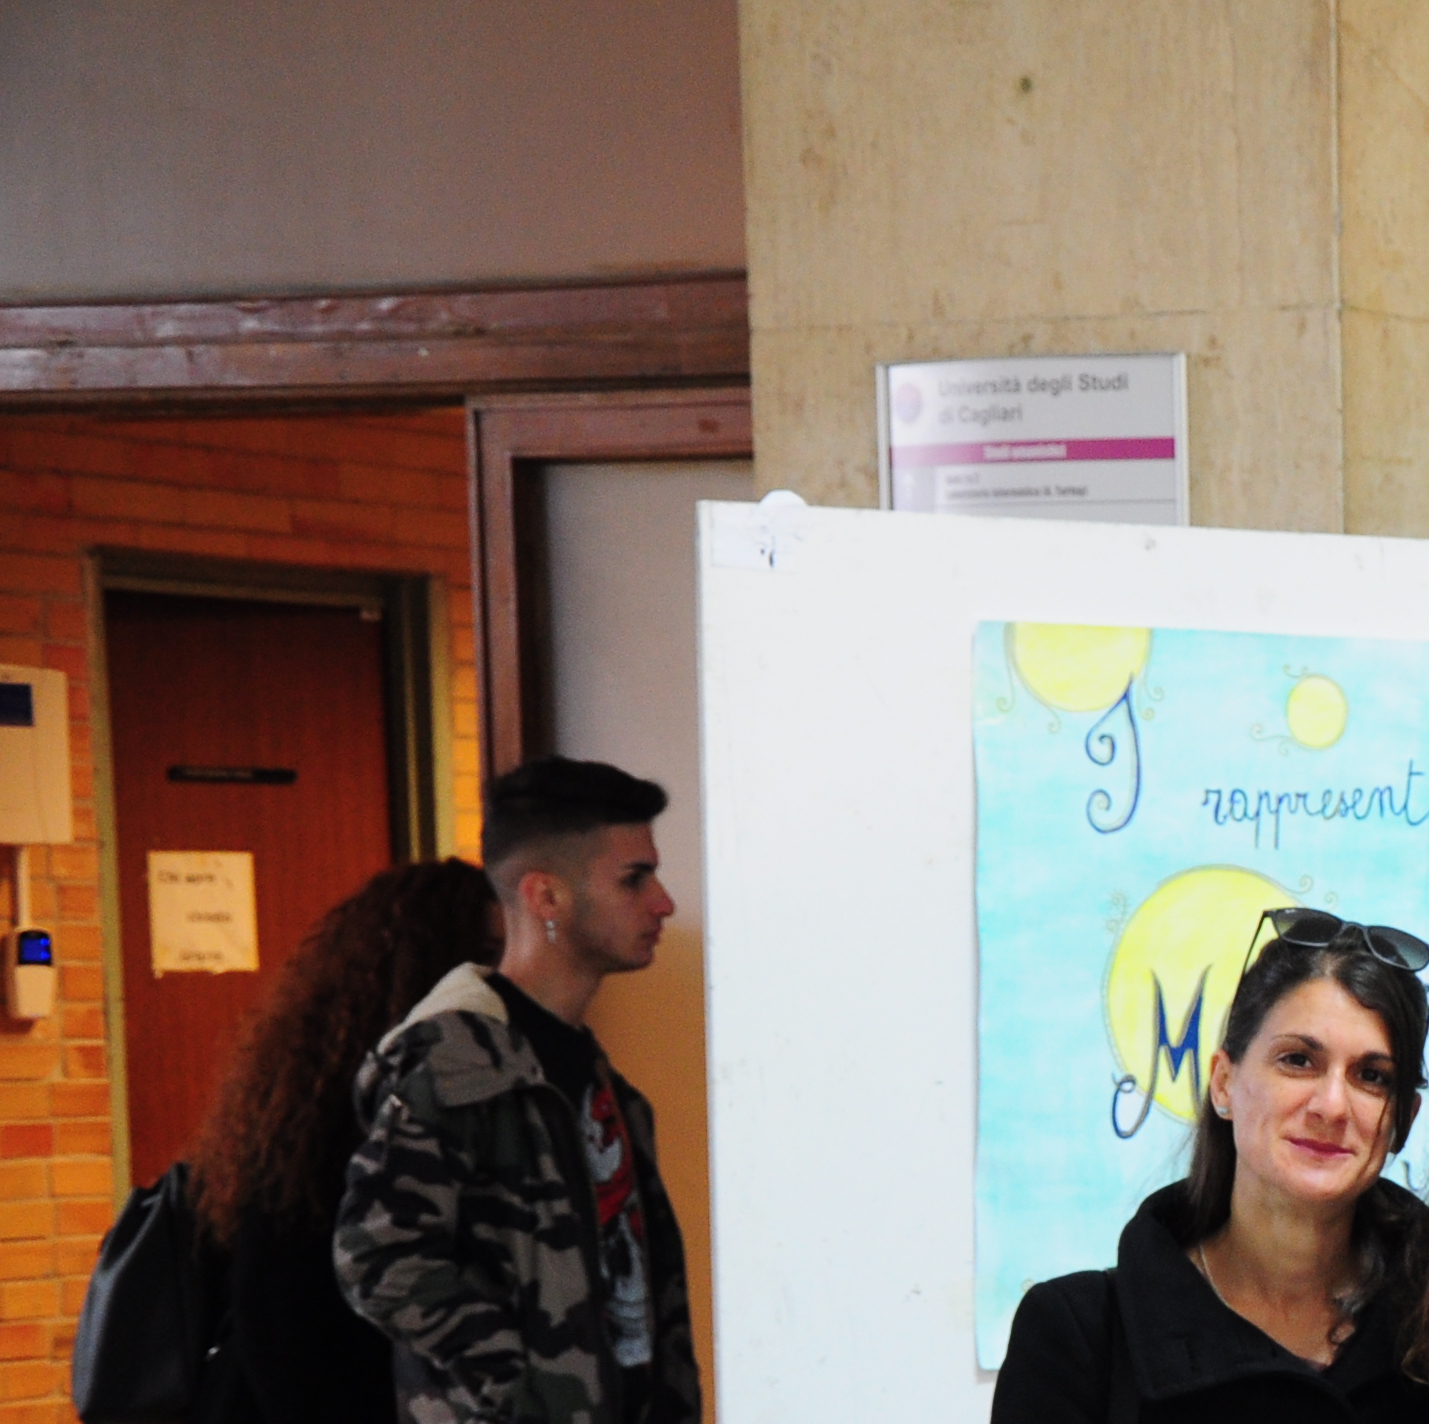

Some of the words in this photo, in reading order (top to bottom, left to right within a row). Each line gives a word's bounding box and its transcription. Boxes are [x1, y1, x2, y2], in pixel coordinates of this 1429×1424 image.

[938, 374, 1021, 396] Università
[1026, 373, 1073, 397] degli
[1077, 371, 1129, 392] Studi
[957, 404, 1023, 427] Cagliari
